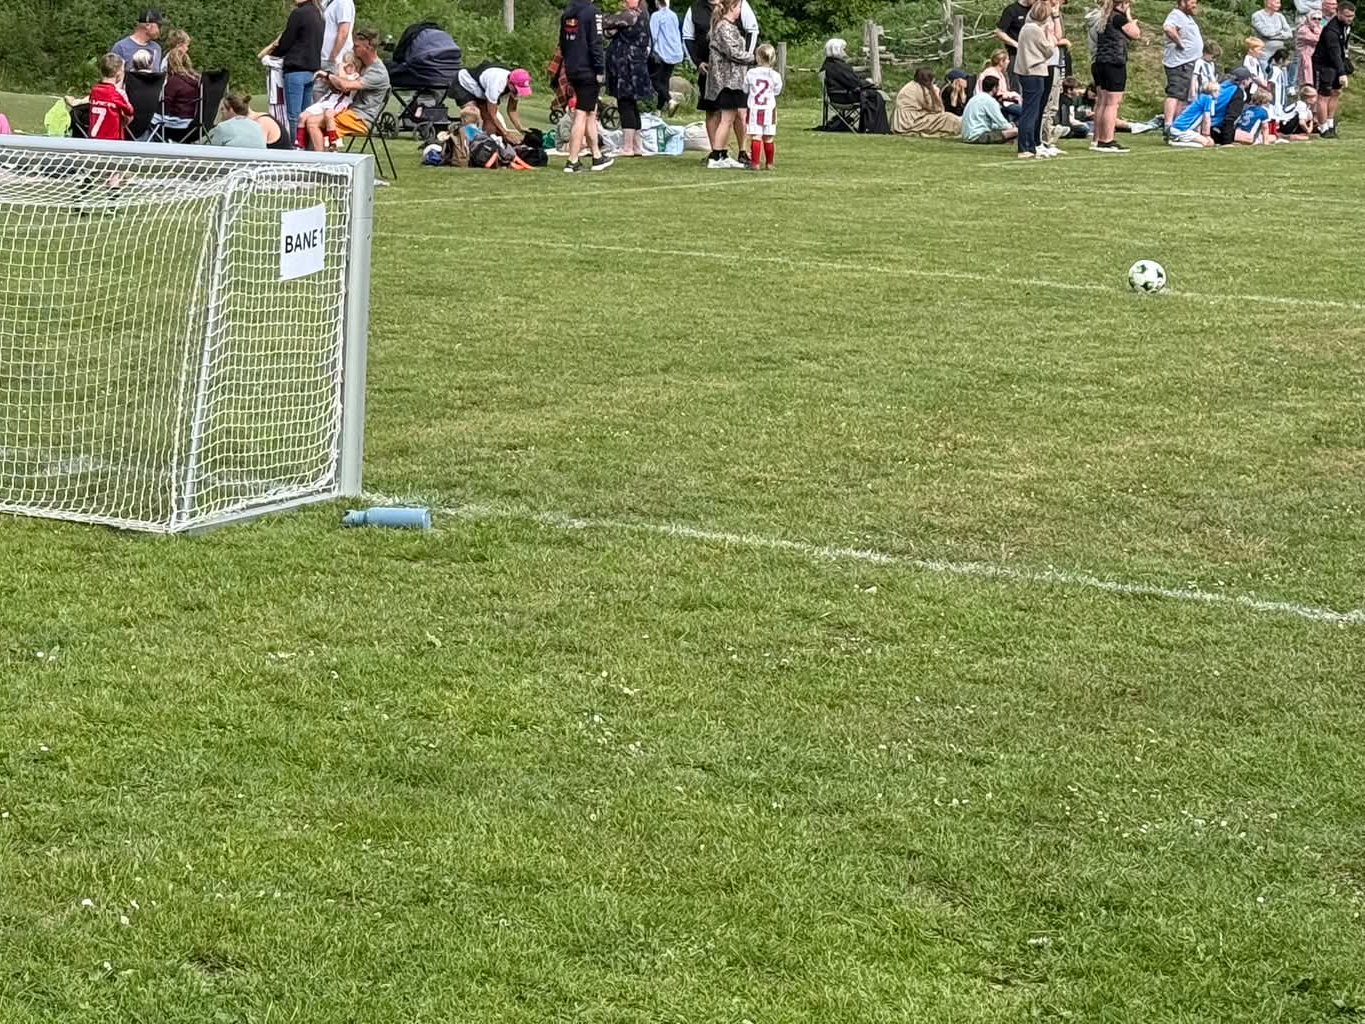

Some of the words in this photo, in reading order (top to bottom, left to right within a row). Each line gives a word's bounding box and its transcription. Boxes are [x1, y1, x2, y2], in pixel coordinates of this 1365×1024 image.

[754, 79, 769, 105] 2
[91, 107, 107, 137] 7
[285, 228, 318, 254] BANE
